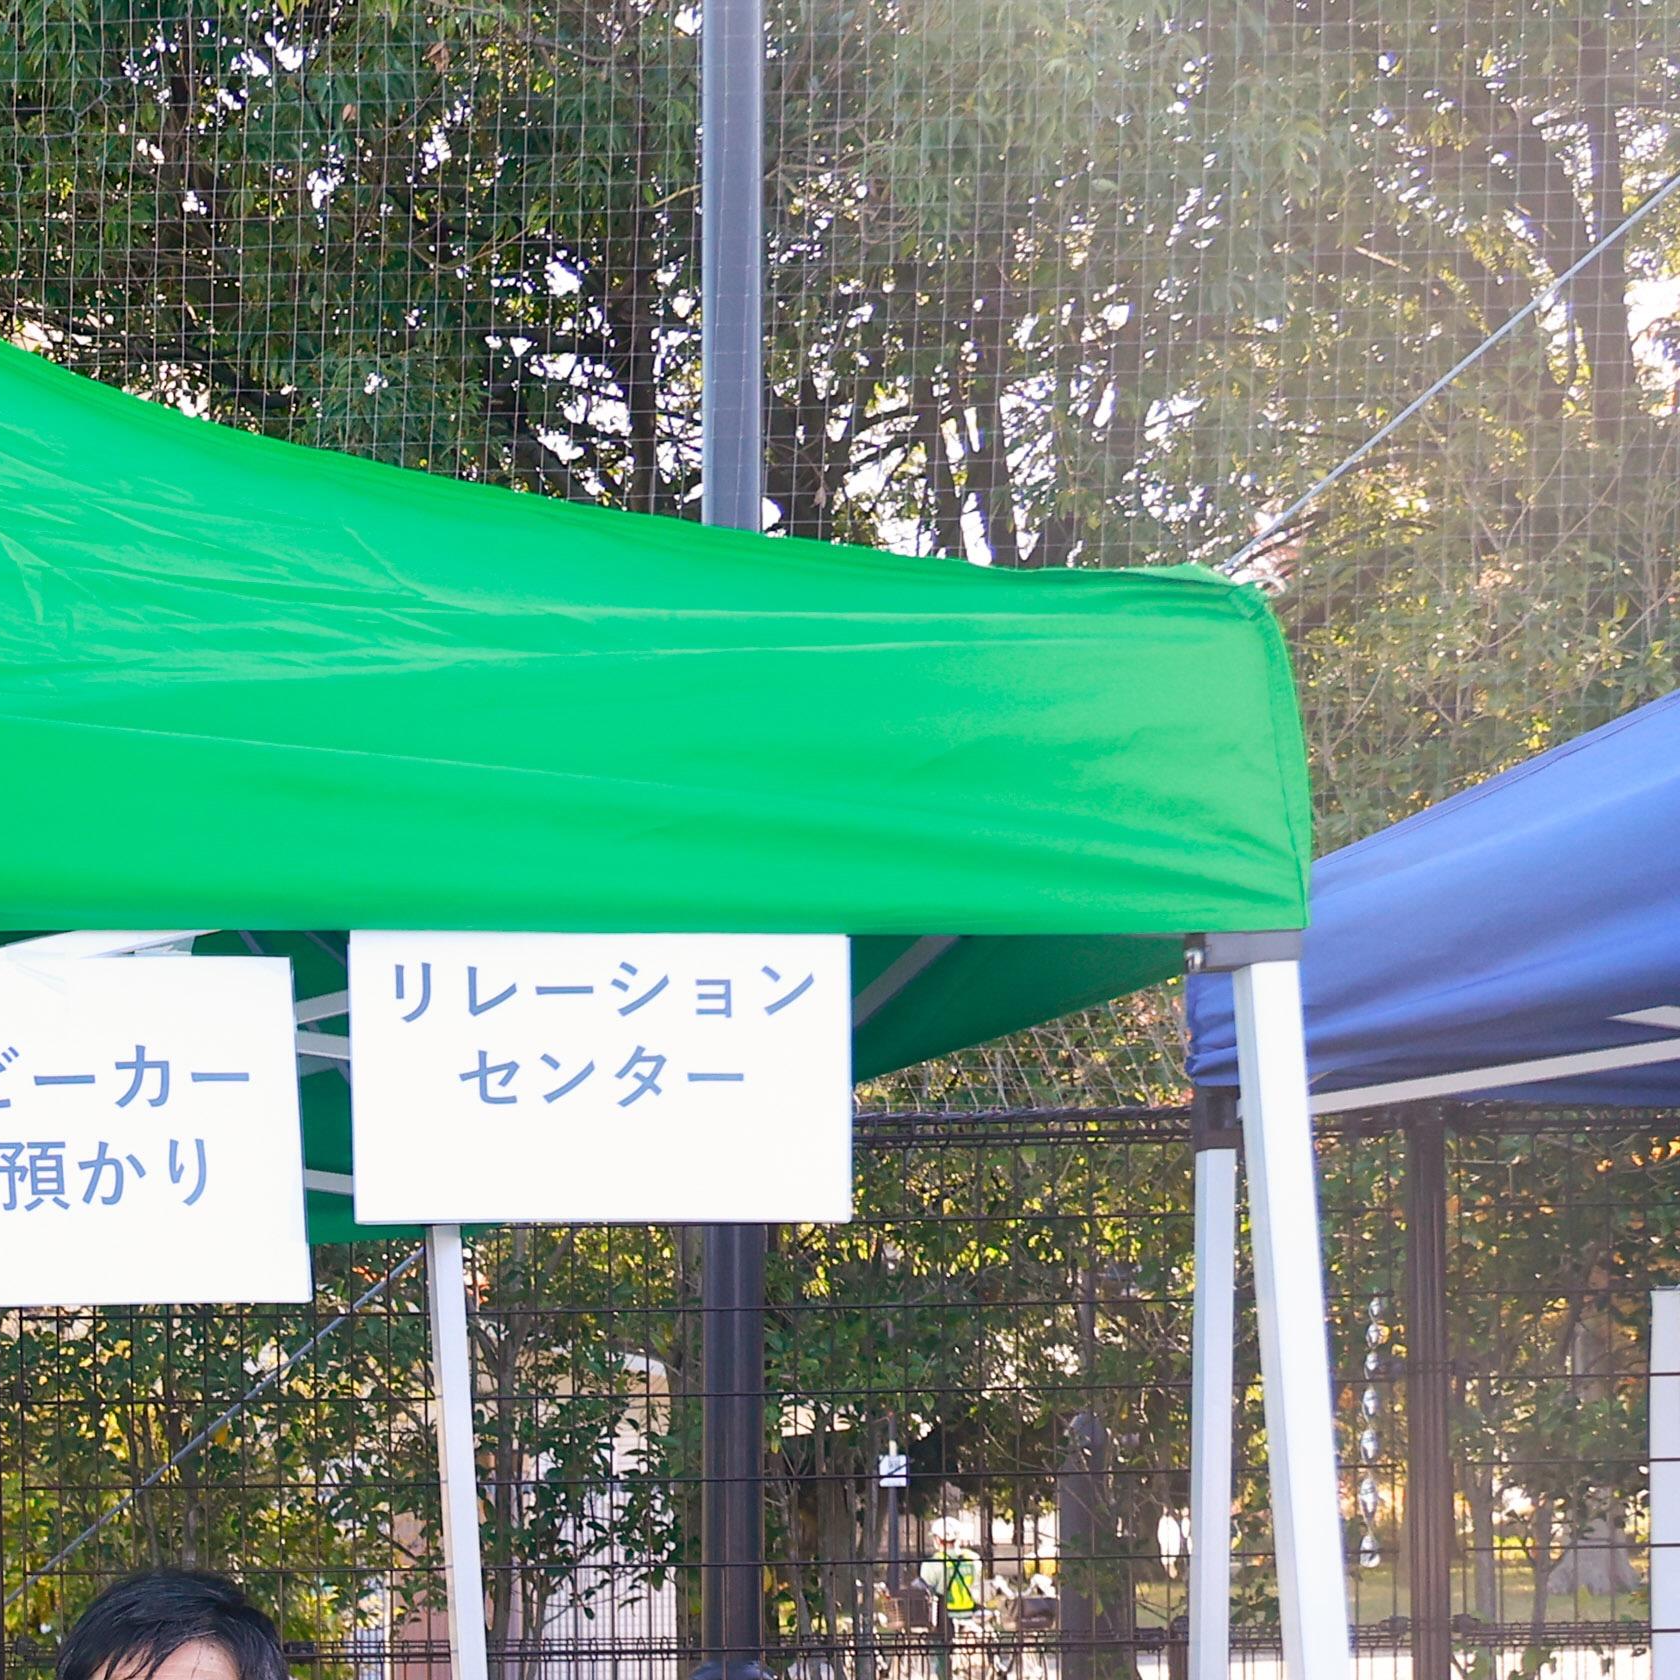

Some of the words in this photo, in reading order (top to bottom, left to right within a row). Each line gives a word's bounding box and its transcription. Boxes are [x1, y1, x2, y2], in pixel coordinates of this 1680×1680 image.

[393, 957, 815, 1023] リレーション
[460, 1044, 746, 1109] センター
